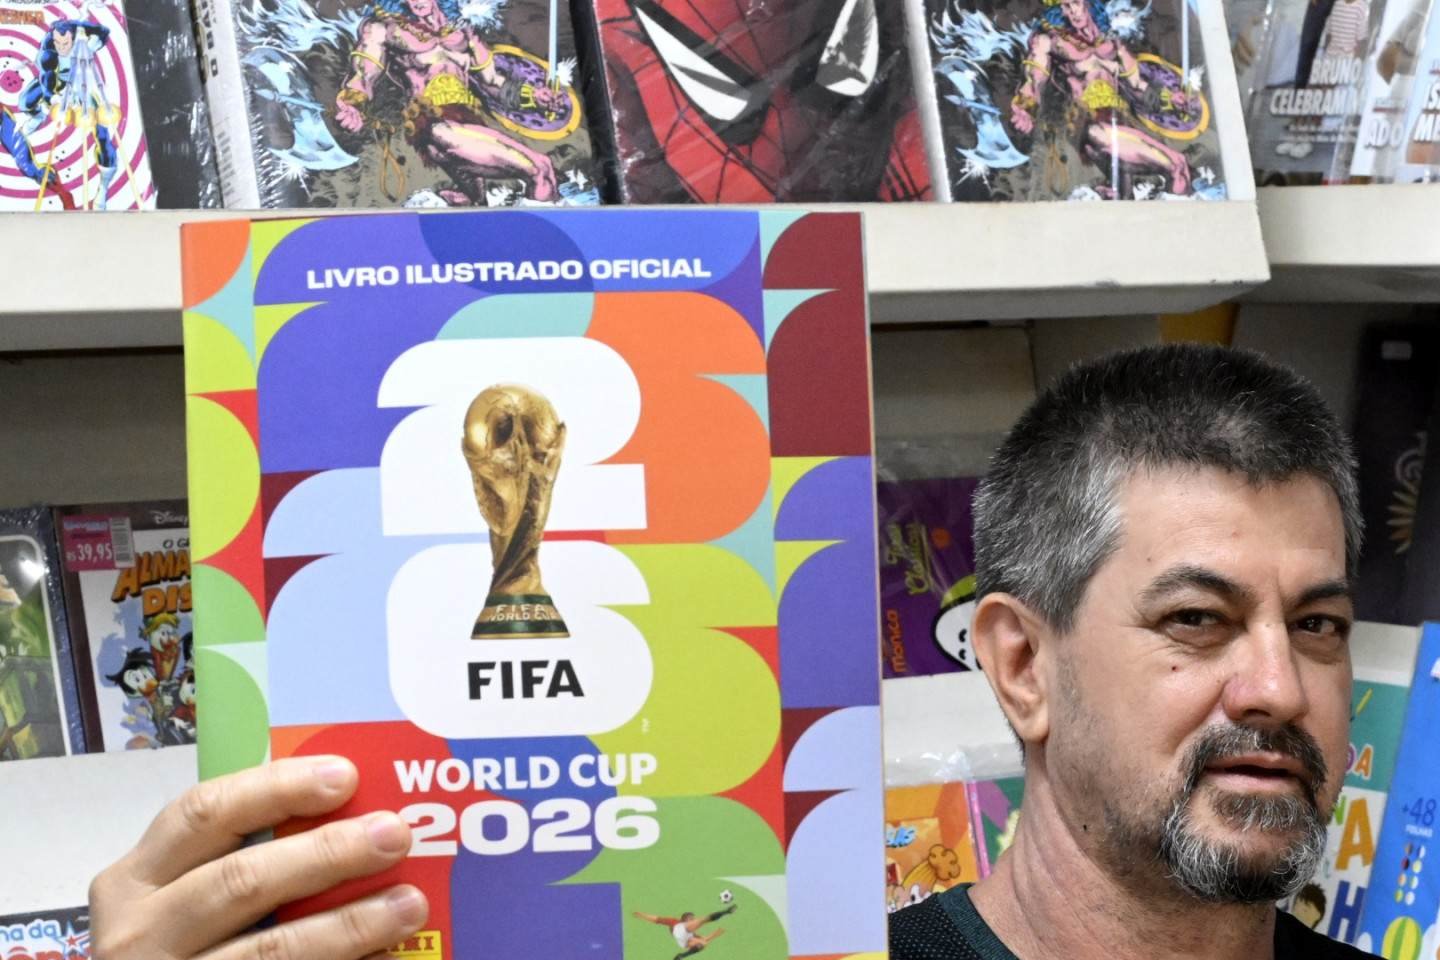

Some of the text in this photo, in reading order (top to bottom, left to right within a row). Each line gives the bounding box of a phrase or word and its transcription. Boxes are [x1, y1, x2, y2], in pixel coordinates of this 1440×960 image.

[307, 258, 711, 289] LIVRO ILUSTRADO OFICIAL
[77, 542, 115, 563] 39,95
[467, 660, 585, 700] FIFA
[393, 753, 658, 793] WORLD CUP
[404, 795, 660, 858] 2026
